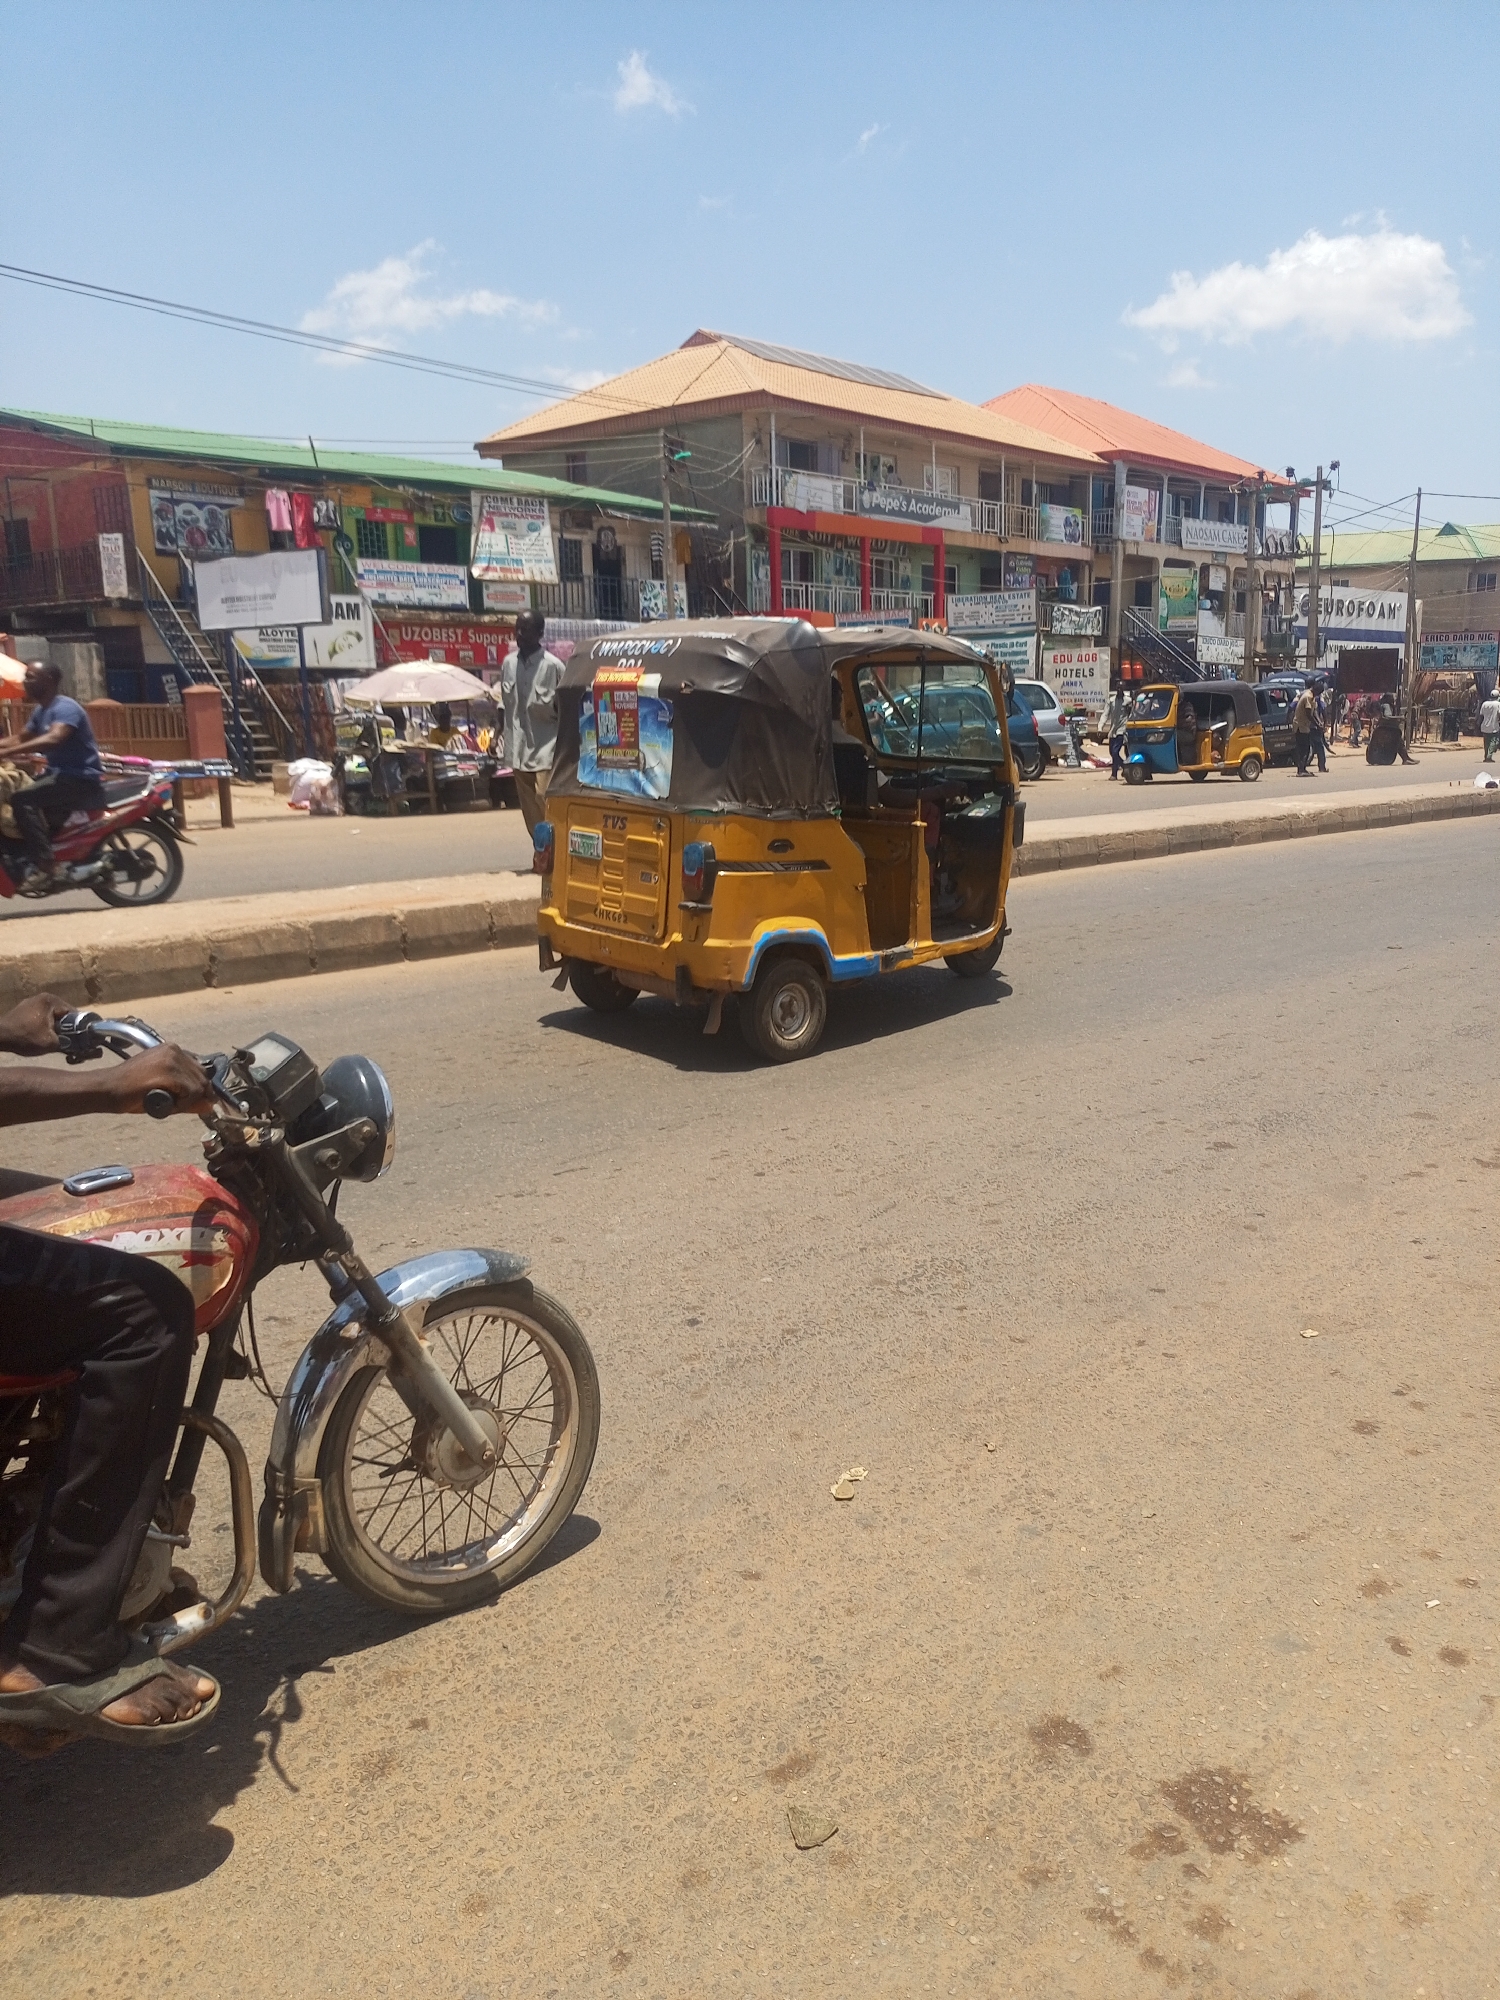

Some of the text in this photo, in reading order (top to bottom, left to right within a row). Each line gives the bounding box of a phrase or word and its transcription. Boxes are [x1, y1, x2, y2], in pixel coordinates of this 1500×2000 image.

[485, 495, 545, 507] COME BACK
[872, 492, 959, 517] Pepe's Academy
[488, 504, 545, 514] NETWORKS
[1221, 529, 1245, 545] CAKES
[361, 561, 422, 572] WELCOME
[427, 564, 459, 574] BACK
[951, 595, 988, 604] LIBERATION
[1008, 591, 1031, 600] ESTATE
[402, 626, 464, 643] UZOBEST
[1425, 634, 1450, 642] ERICO
[1477, 633, 1496, 641] NIG.
[991, 641, 1008, 649] Plastic
[1015, 640, 1027, 648] Card
[1053, 653, 1073, 664] EDU
[1055, 667, 1095, 679] HOTELS
[603, 814, 628, 830] TVS
